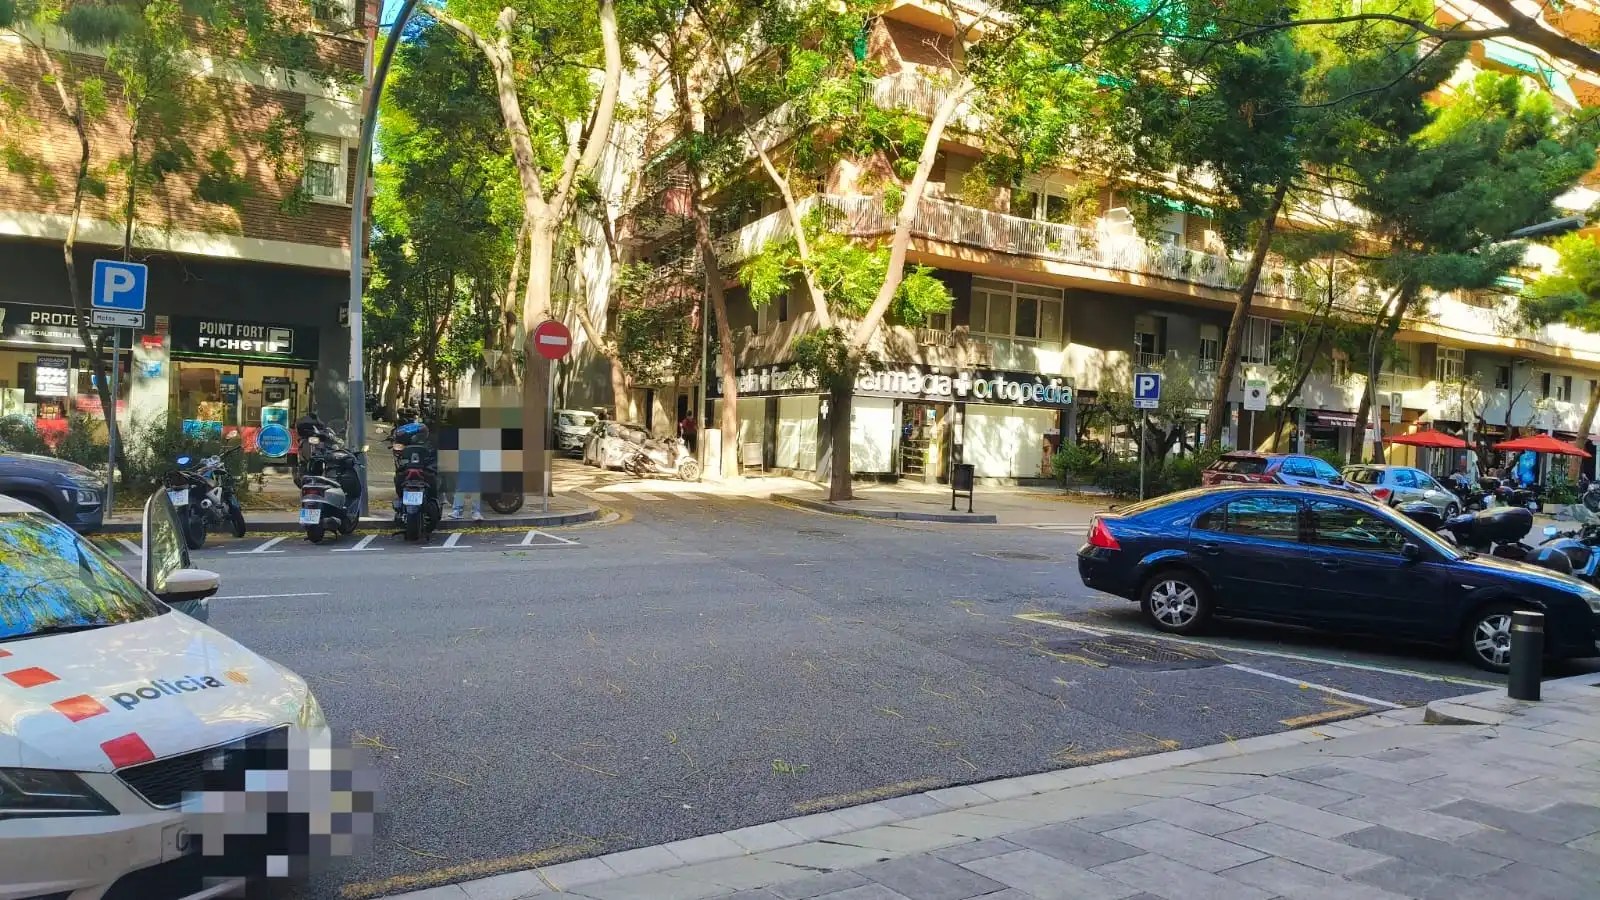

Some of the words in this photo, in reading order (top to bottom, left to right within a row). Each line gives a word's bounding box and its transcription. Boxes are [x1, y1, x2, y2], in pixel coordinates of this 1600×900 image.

[104, 266, 135, 303] P
[31, 311, 108, 329] PROTEG
[199, 321, 234, 336] POINT
[236, 324, 265, 339] FORT
[1139, 376, 1155, 397] P
[109, 675, 225, 711] policia
